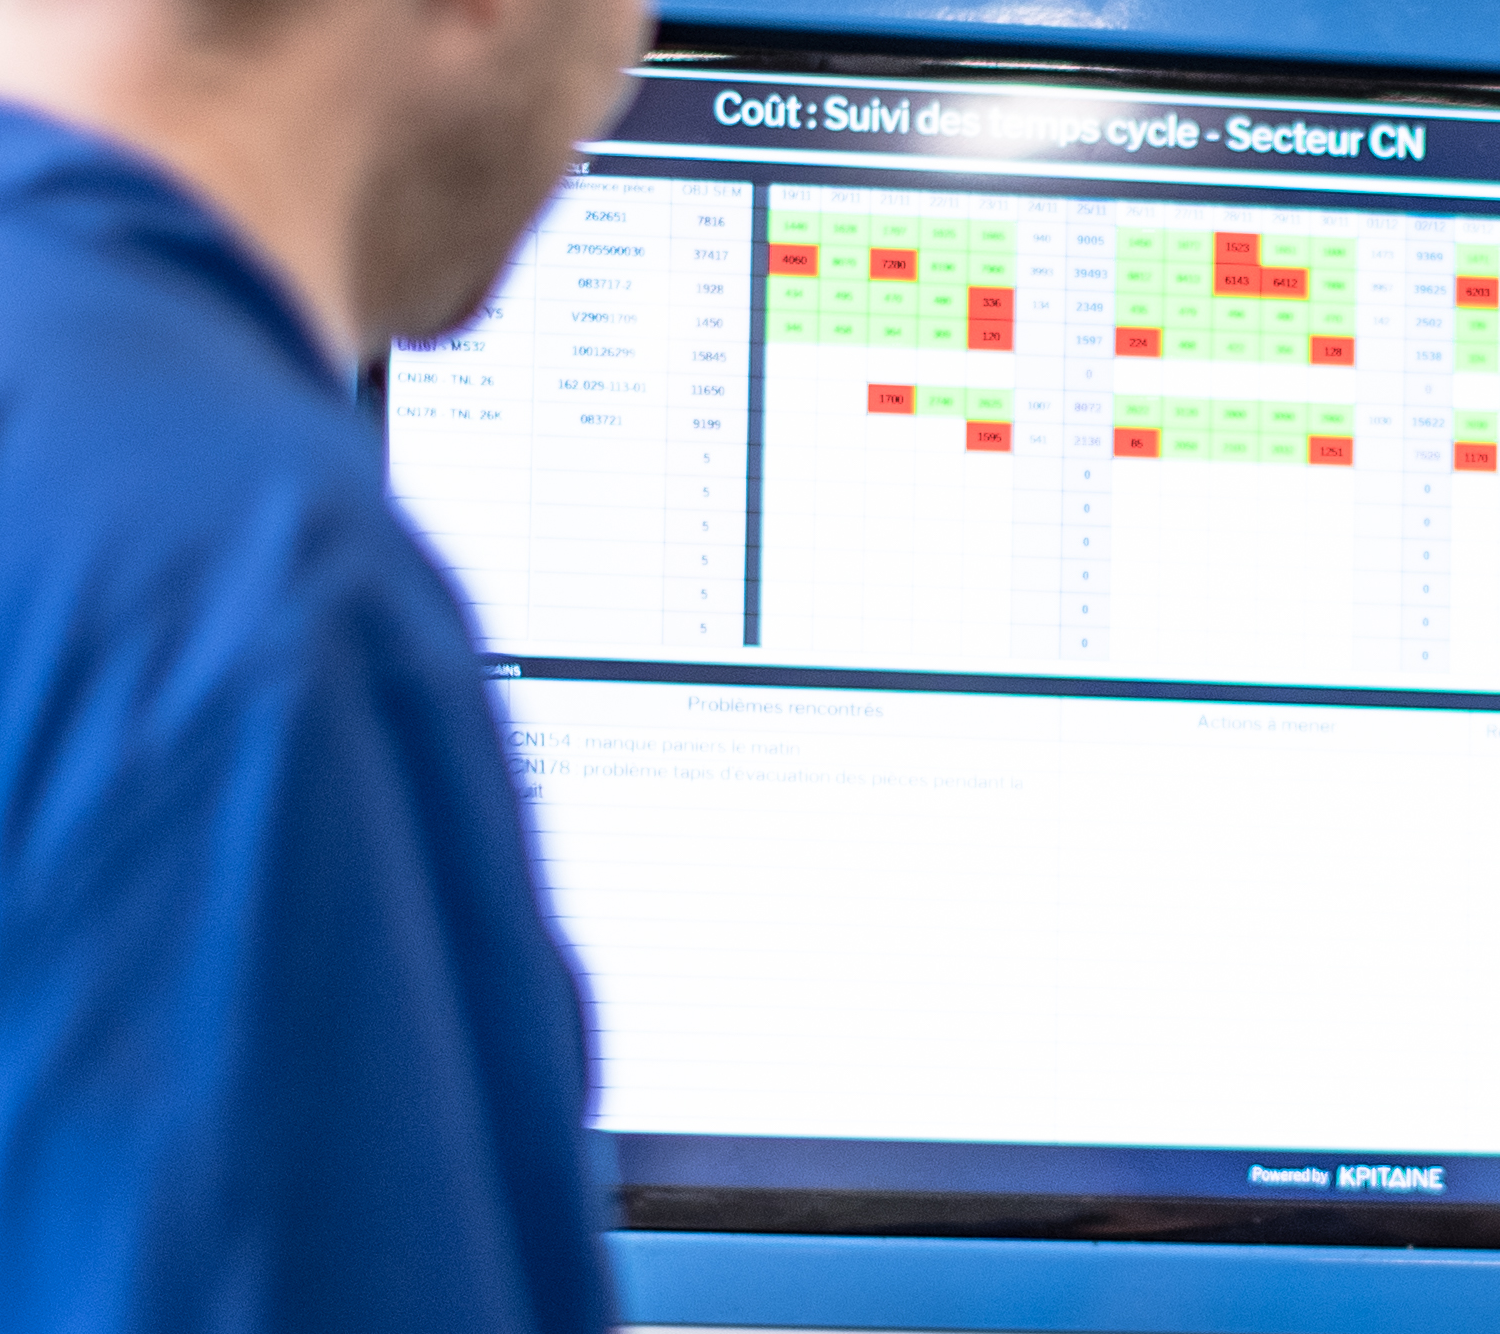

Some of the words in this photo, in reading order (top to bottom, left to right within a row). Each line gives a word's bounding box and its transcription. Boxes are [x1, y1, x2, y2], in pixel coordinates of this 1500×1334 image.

[714, 89, 802, 129] Coût
[823, 95, 909, 134] Suivi
[916, 102, 980, 136] des
[990, 105, 1101, 147] temps
[1107, 112, 1199, 153] cycle
[1226, 115, 1363, 157] Secteur
[1368, 124, 1426, 161] CN
[698, 215, 725, 228] 7816
[1077, 235, 1105, 246] 9005
[693, 249, 728, 261] 37417
[1074, 268, 1108, 280] 39493
[1225, 276, 1249, 285] 6143
[696, 283, 724, 295] 1928
[1413, 284, 1447, 295] 39625
[1076, 302, 1104, 313] 2349
[695, 317, 723, 329] 1450
[1416, 318, 1442, 328] 2502
[1076, 335, 1102, 345] 1597
[692, 351, 727, 363] 15845
[1325, 347, 1342, 357] 128
[1416, 351, 1442, 361] 1538
[691, 385, 725, 397] 11650
[692, 419, 721, 431] 9199
[1412, 417, 1445, 428] 15622
[687, 695, 783, 715] Problèmes
[788, 700, 884, 719] rencontrés
[1196, 713, 1262, 732] Actions
[1281, 720, 1337, 734] mener
[510, 730, 571, 748] CN154
[585, 735, 657, 753] manque
[662, 738, 727, 755] paniers
[751, 739, 800, 755] matin
[583, 763, 668, 779] problème
[1251, 1166, 1309, 1182] Powered
[1312, 1167, 1328, 1185] by
